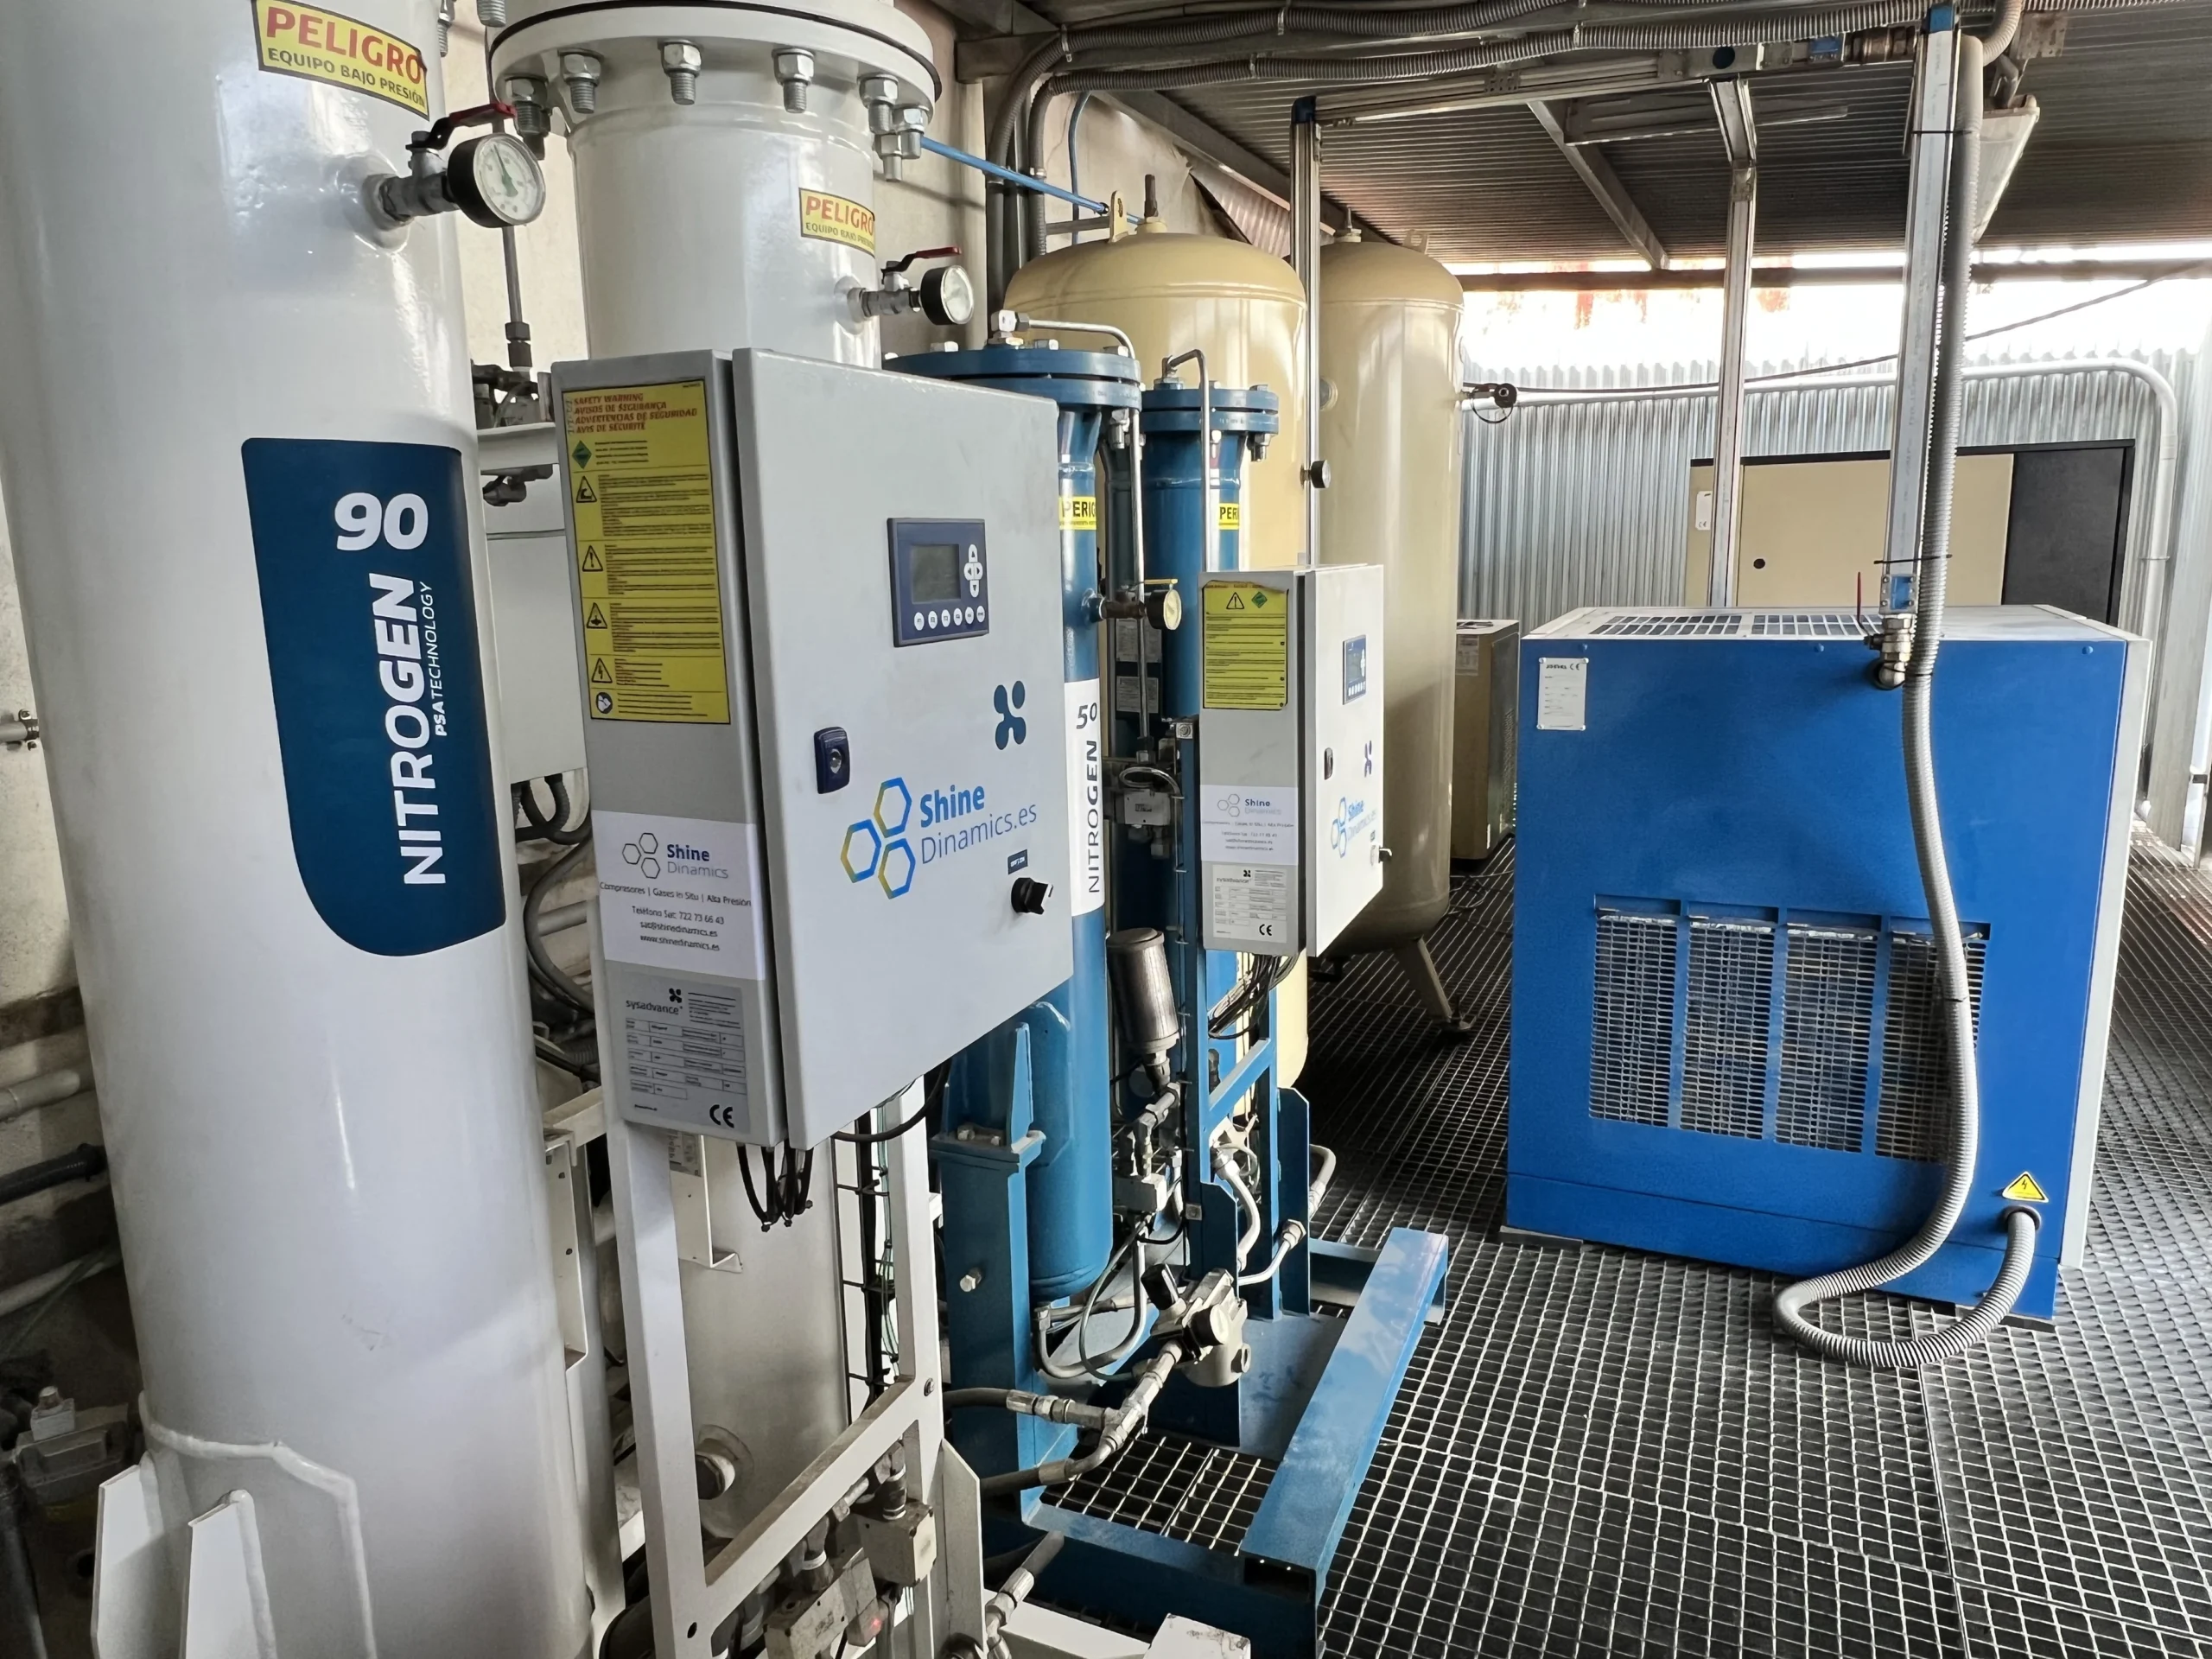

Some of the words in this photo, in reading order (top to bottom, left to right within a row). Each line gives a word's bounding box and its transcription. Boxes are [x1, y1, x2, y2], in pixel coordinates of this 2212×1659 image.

[266, 6, 423, 85] PELIGRO
[268, 48, 335, 73] EQUIPO
[340, 65, 377, 86] BAJO
[380, 76, 426, 107] PRESIÓN
[805, 195, 874, 237] PELIGRO
[805, 222, 838, 236] EQUIPO
[841, 229, 856, 241] BAJO
[574, 395, 602, 405] SAFETY
[604, 393, 644, 403] WARNING
[575, 405, 603, 415] AVISOS
[606, 404, 616, 413] DE
[575, 412, 634, 424] ADVERTENCIAS
[636, 411, 647, 421] DE
[649, 408, 697, 420] SEGURIDAD
[576, 424, 594, 433] AVIS
[596, 424, 607, 433] DE
[334, 492, 429, 551] 90
[1076, 702, 1097, 729] 50
[368, 572, 446, 885] NITROGEN
[920, 785, 985, 828] Shine
[1245, 798, 1270, 807] Shine
[1086, 740, 1100, 893] NITROGEN
[921, 804, 1037, 864] Dinamics.es
[667, 844, 709, 861] Shine
[667, 861, 728, 879] Dinamics
[653, 888, 675, 898] Gases
[707, 894, 721, 904] Alta
[679, 911, 692, 921] 722
[695, 913, 703, 923] 73
[704, 913, 714, 924] 66
[715, 916, 724, 925] 43
[1259, 924, 1273, 937] CE
[626, 1000, 679, 1015] sysadvance
[709, 1104, 734, 1128] CE
